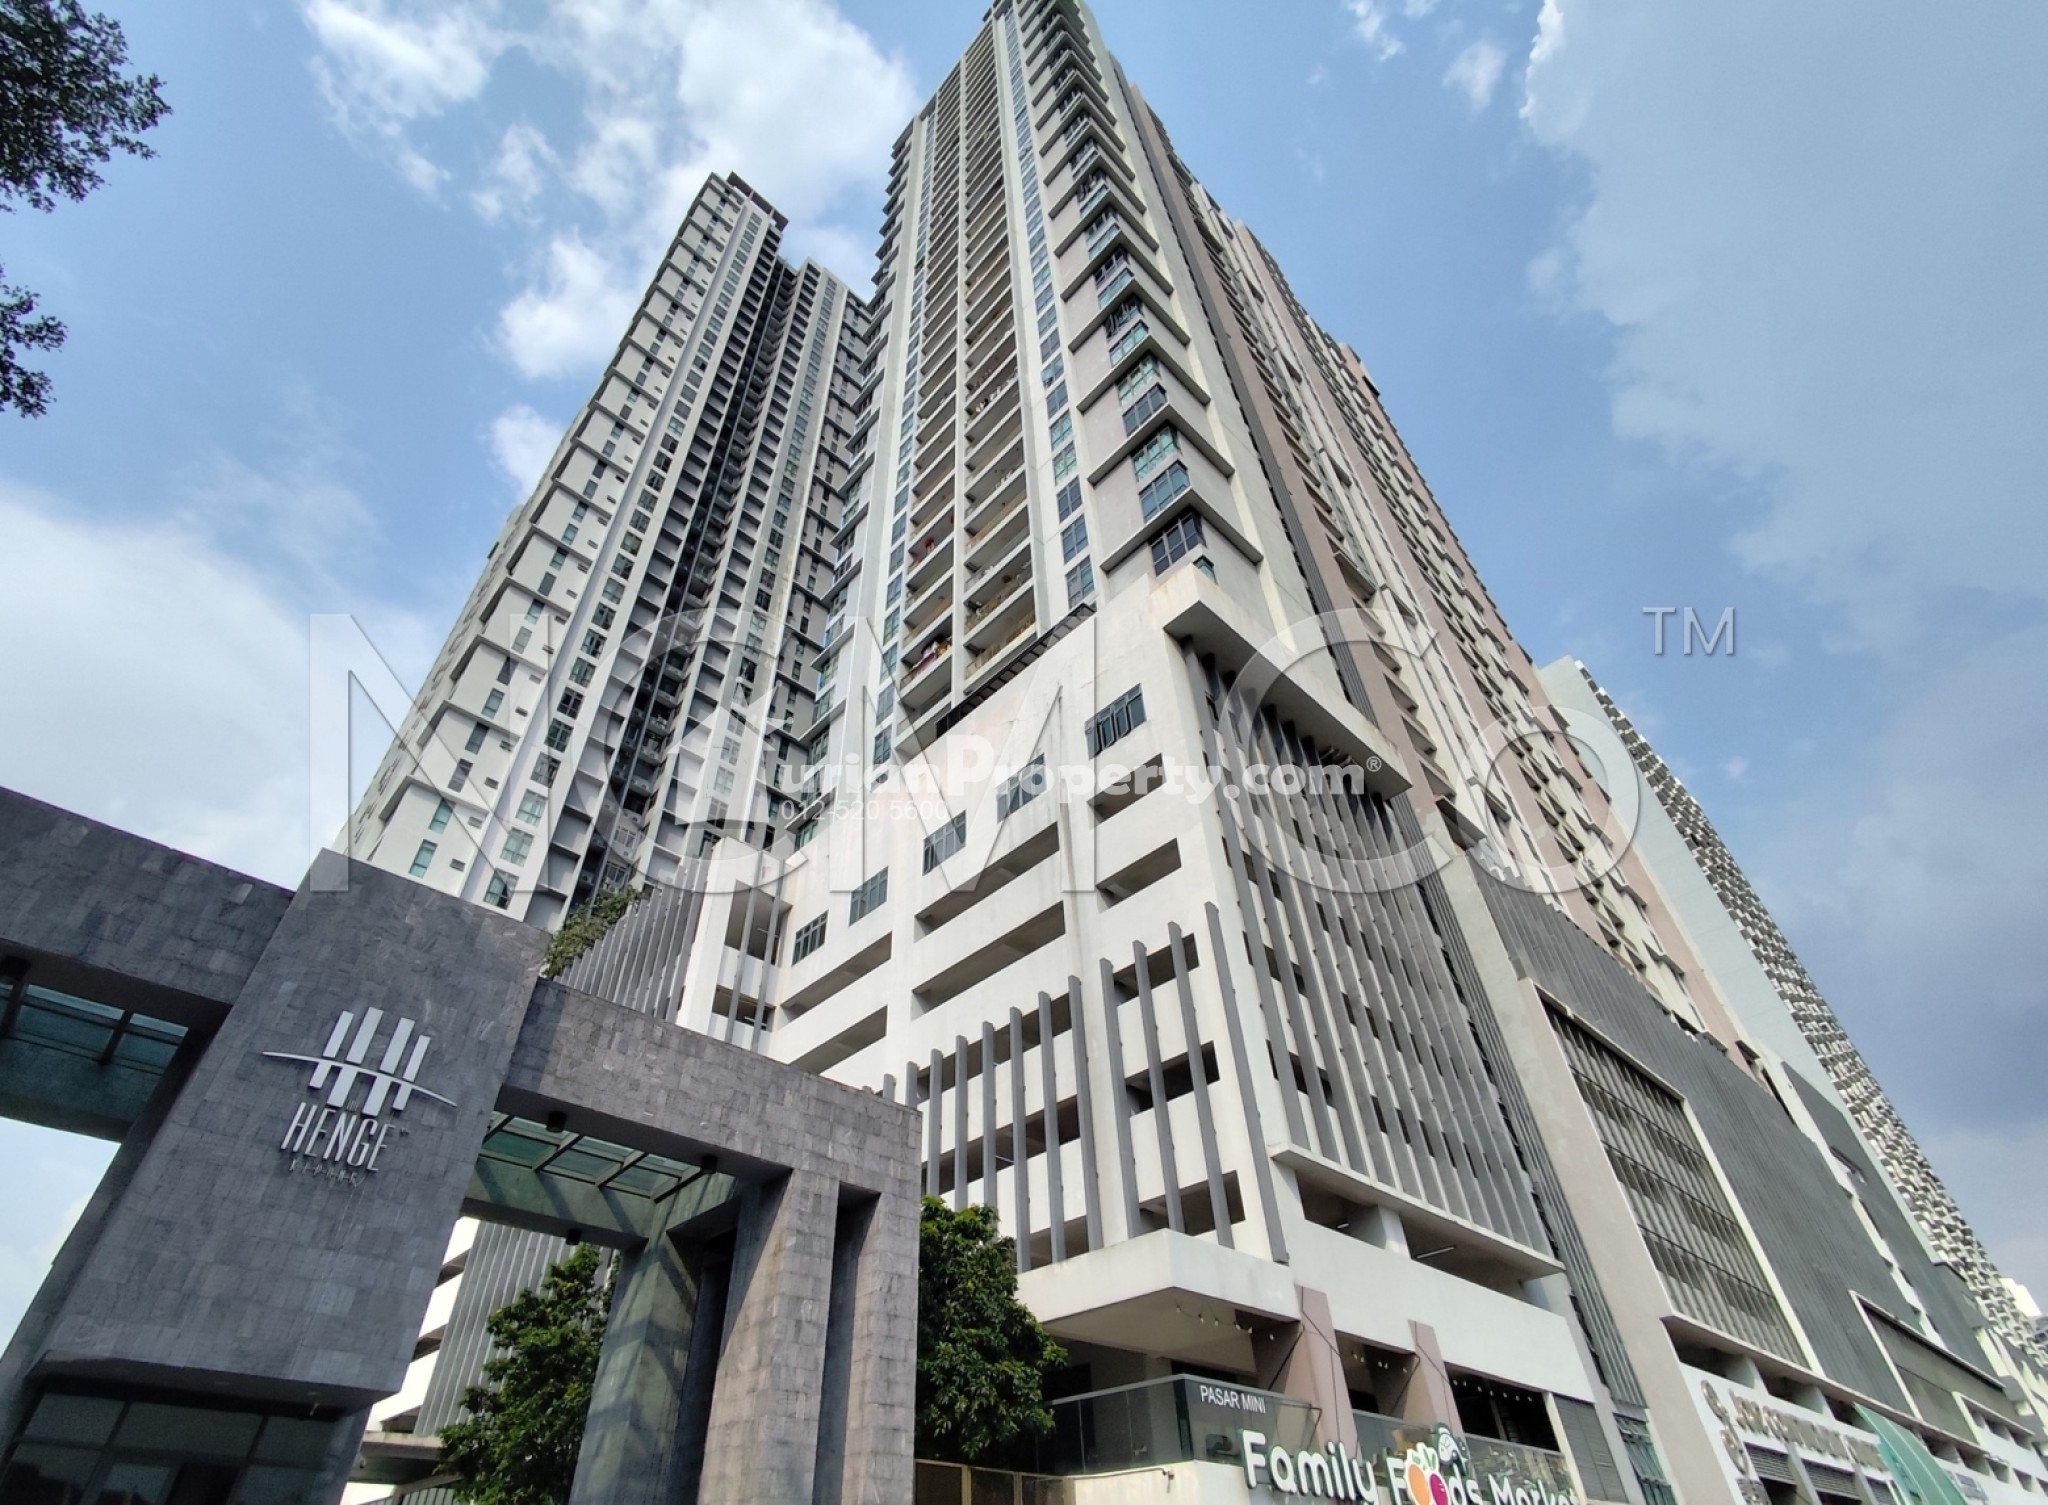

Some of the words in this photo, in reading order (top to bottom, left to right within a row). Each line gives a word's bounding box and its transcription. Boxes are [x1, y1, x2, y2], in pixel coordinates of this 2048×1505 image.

[280, 1101, 396, 1173] HENGE
[1200, 1385, 1240, 1410] PASAR
[1241, 1393, 1266, 1414] MINI
[1242, 1429, 1379, 1505] Family
